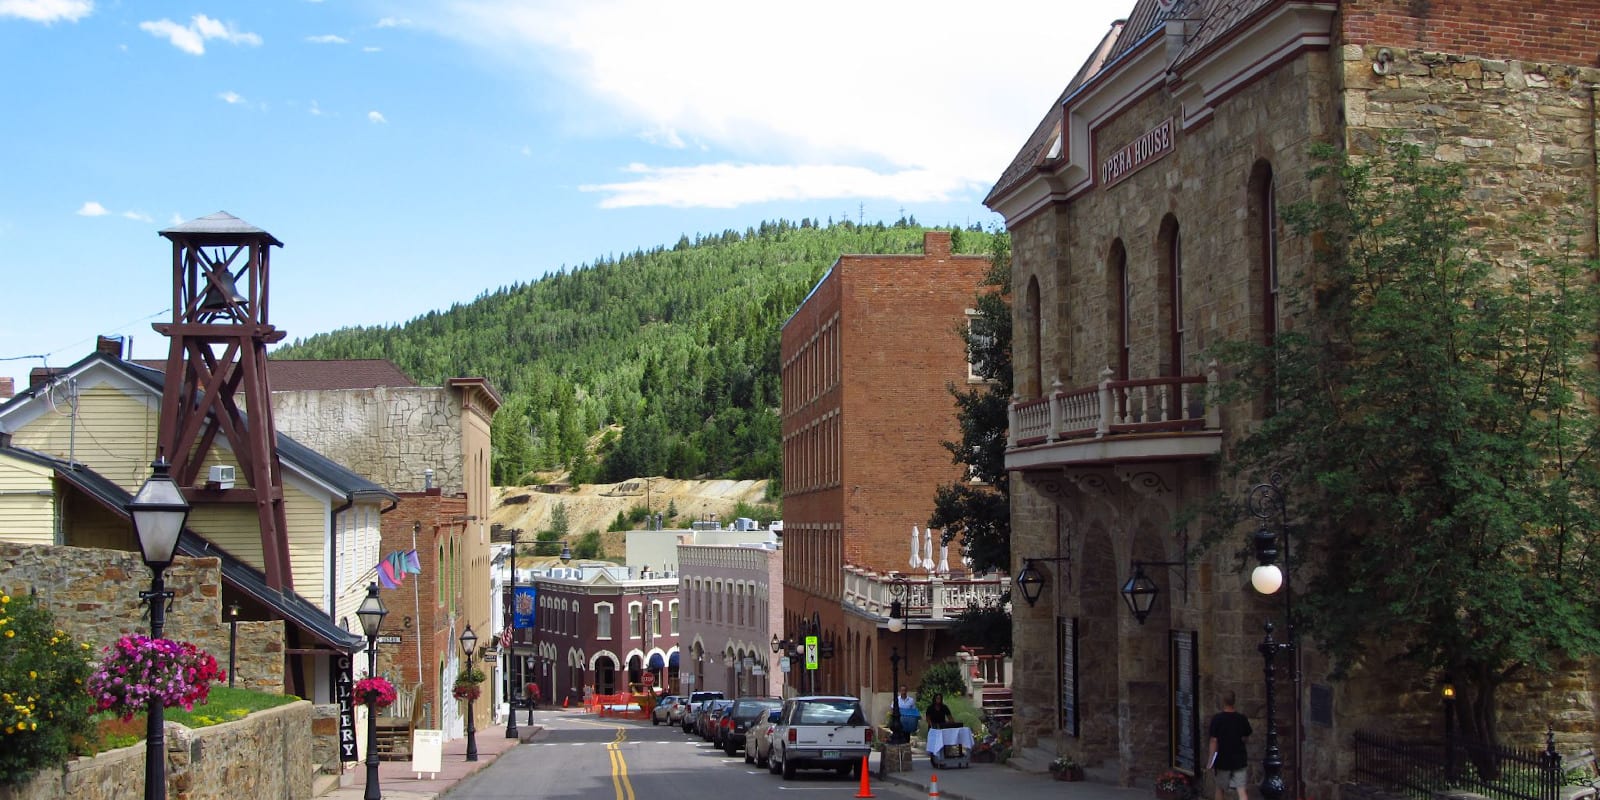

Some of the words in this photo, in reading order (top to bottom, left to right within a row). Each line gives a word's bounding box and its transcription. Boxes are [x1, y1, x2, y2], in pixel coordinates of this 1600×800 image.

[1102, 146, 1132, 184] OPERA
[1135, 123, 1168, 165] HOUSE
[338, 657, 354, 756] GALLERY
